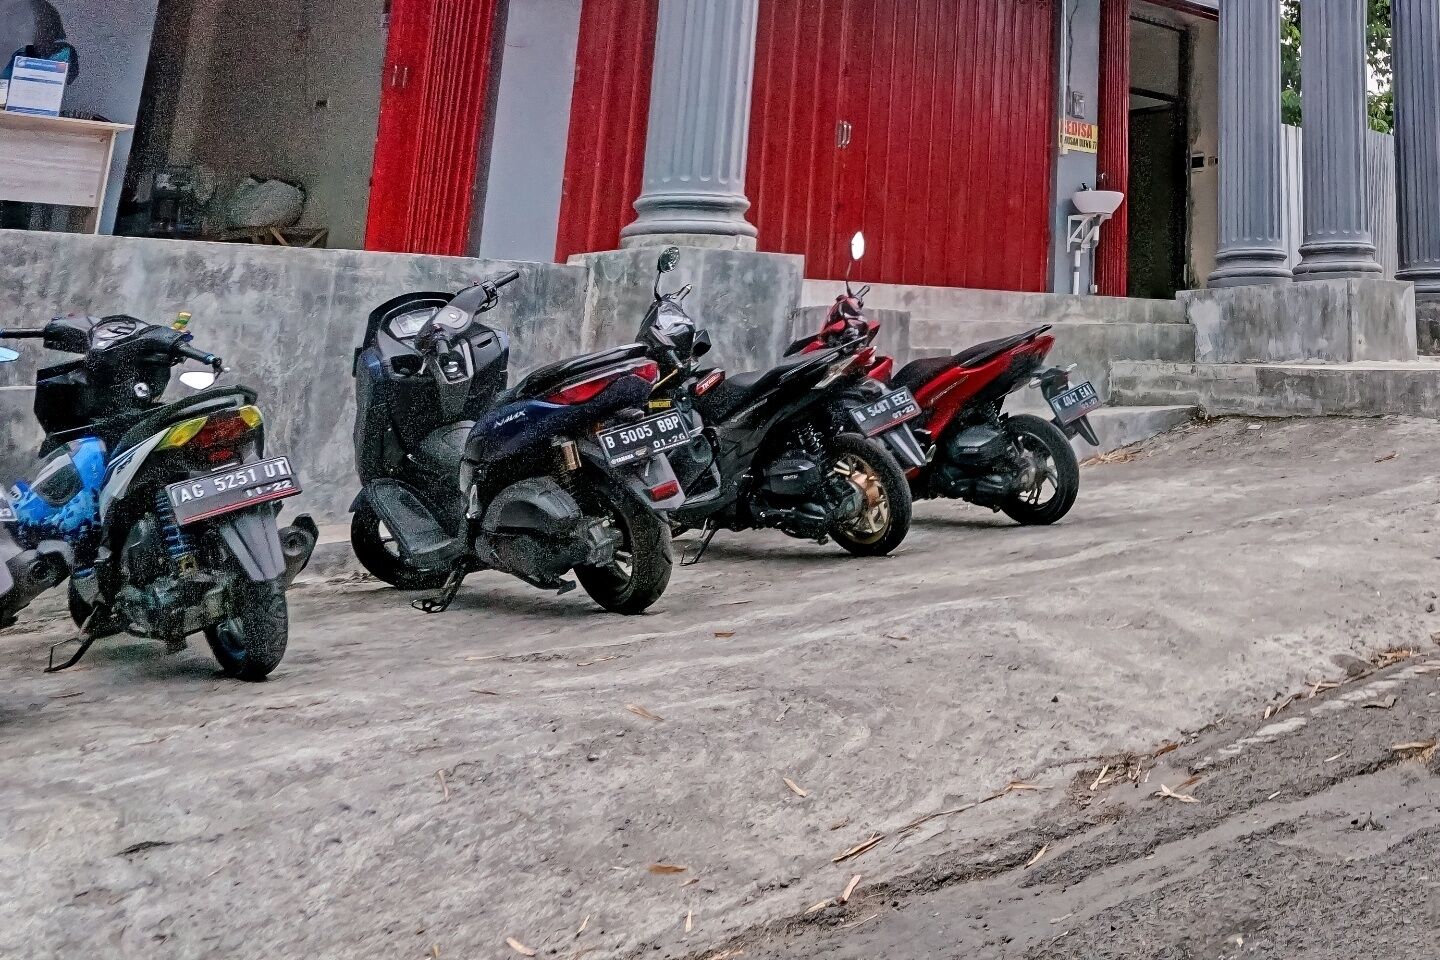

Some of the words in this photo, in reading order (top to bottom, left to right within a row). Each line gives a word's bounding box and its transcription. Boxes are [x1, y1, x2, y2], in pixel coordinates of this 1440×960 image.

[606, 436, 616, 449] B
[620, 424, 653, 445] 5005
[656, 415, 679, 433] BBP
[181, 483, 205, 503] AG
[213, 468, 257, 492] 5251
[263, 460, 288, 478] UT
